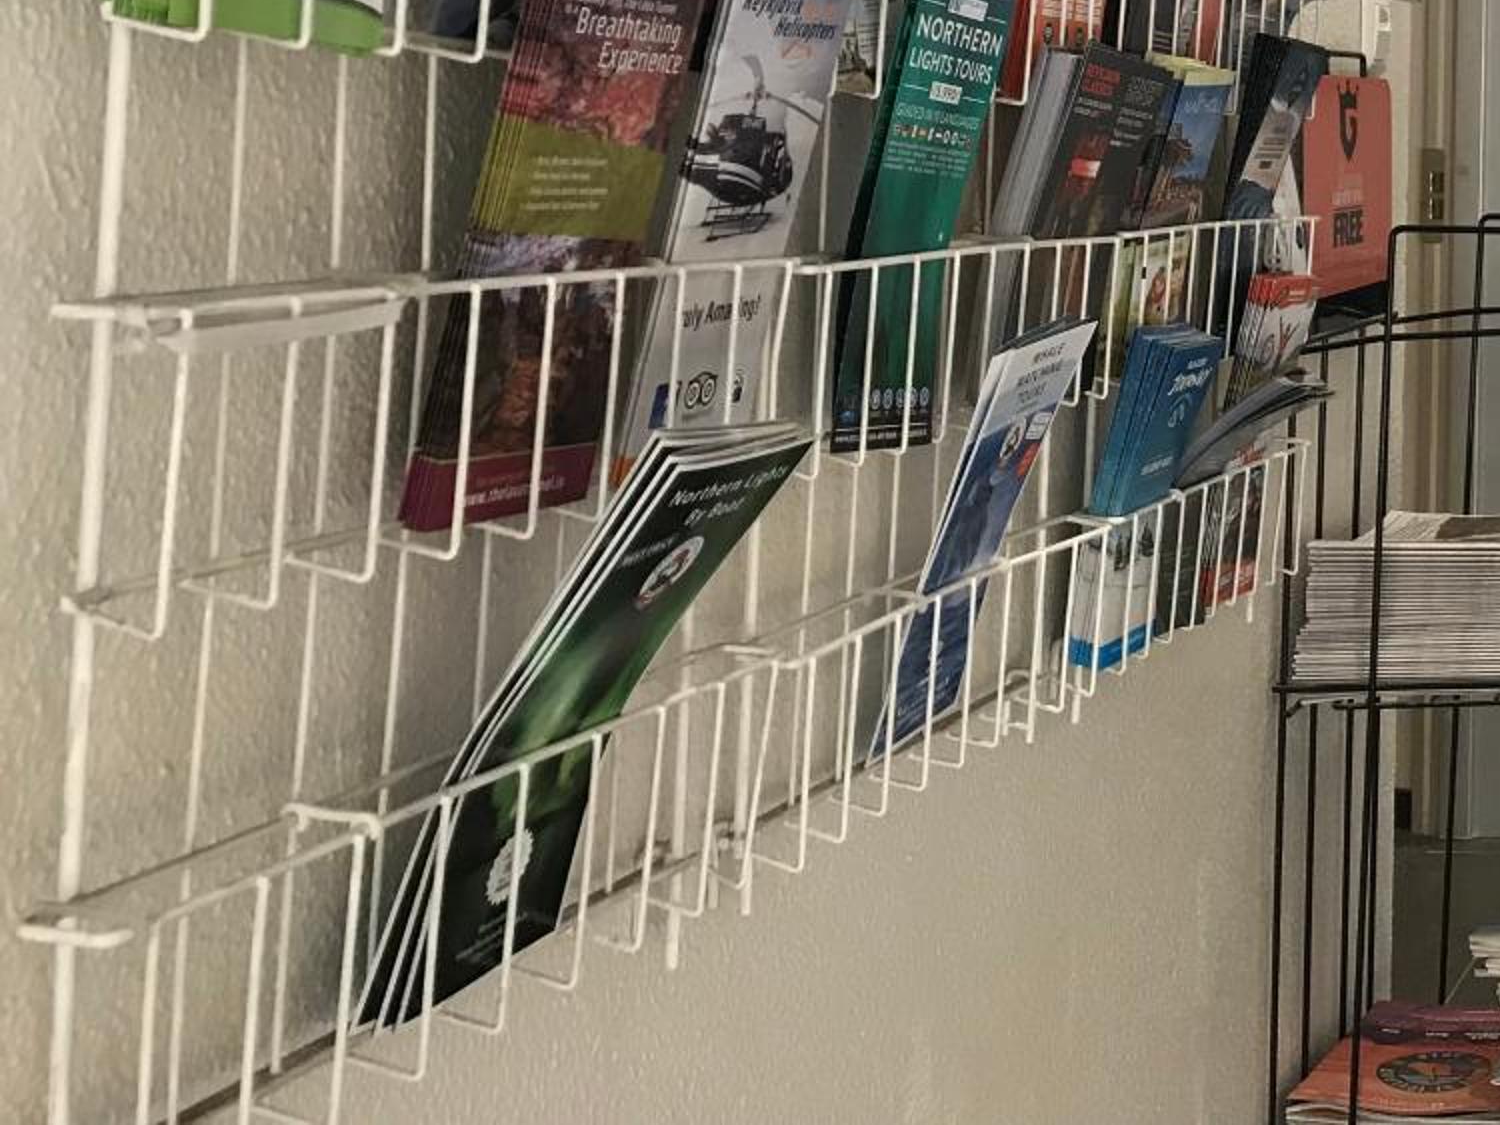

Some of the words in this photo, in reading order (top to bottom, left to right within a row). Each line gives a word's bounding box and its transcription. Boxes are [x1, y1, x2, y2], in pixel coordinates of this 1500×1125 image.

[575, 6, 682, 51] Breathtaking
[916, 12, 1003, 58] NORTHERN
[598, 41, 684, 74] Experience
[909, 46, 952, 76] LIGHTS
[954, 57, 993, 86] TOURS
[668, 478, 744, 507] Northern
